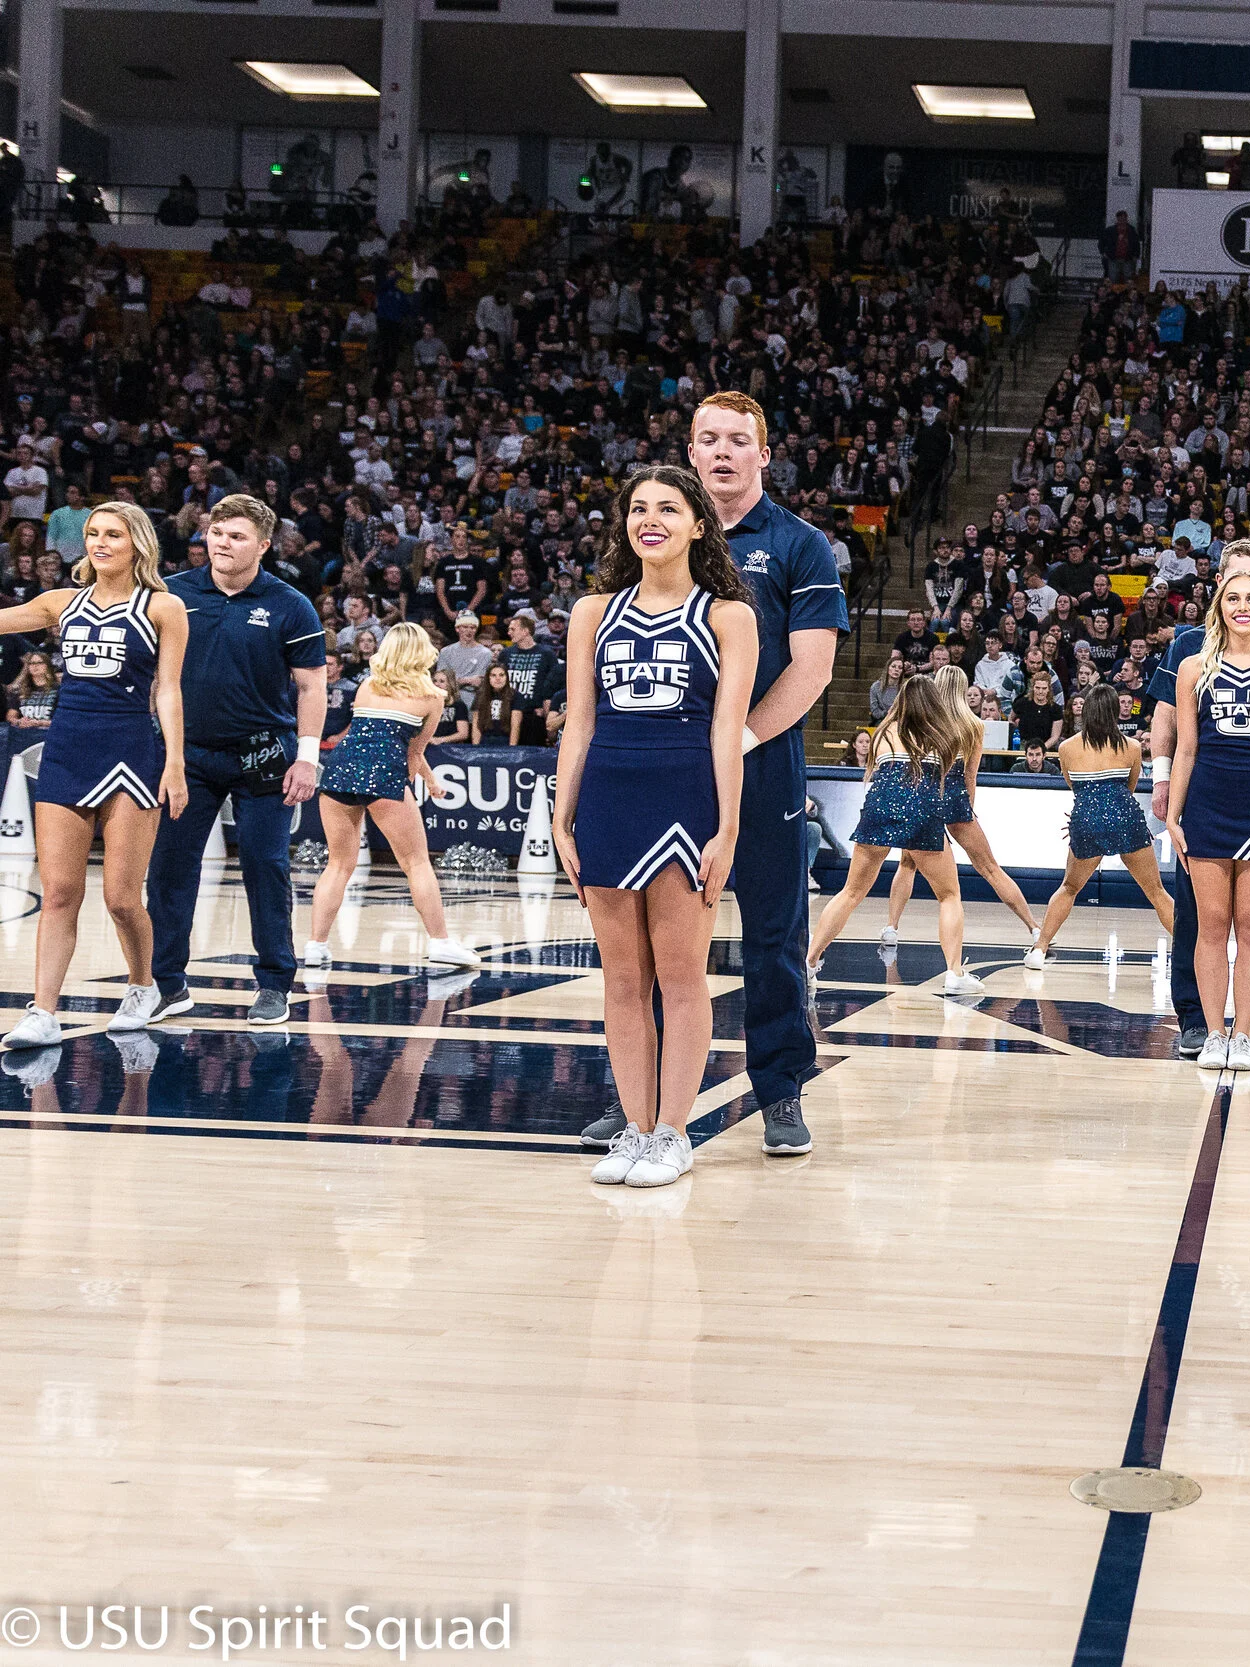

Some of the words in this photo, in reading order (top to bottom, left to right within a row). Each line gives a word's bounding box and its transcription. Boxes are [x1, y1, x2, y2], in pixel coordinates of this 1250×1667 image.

[751, 146, 765, 163] K
[1117, 160, 1130, 178] L
[742, 564, 769, 575] AGGIES
[61, 640, 127, 661] STATE
[64, 625, 127, 679] U
[507, 669, 537, 683] TRUE
[601, 662, 690, 689] STATE
[604, 639, 689, 712] U
[19, 705, 53, 719] TRUE
